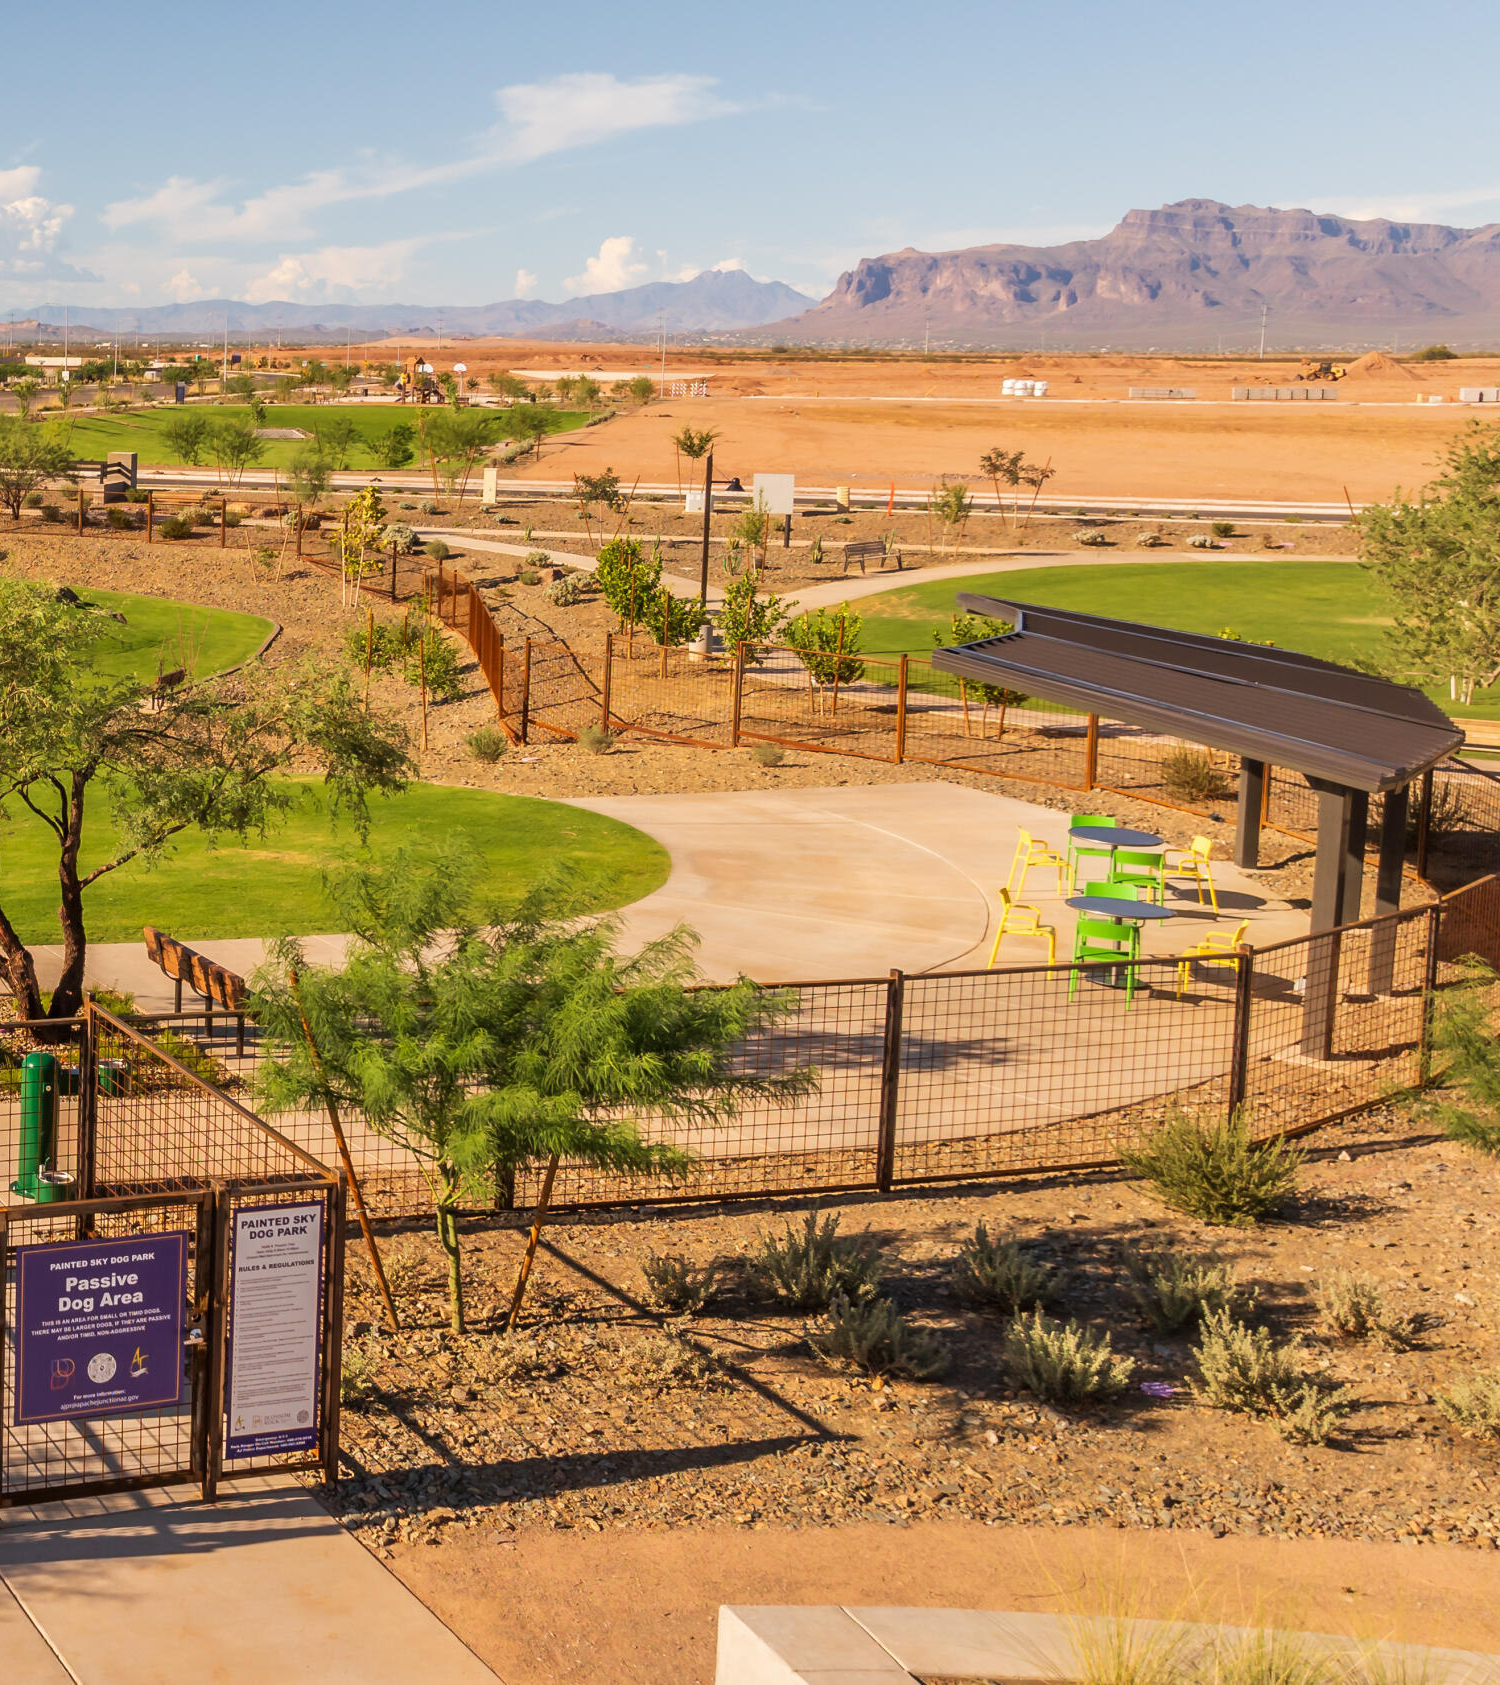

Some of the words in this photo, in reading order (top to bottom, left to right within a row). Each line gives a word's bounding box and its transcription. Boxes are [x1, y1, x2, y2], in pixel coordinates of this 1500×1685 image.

[241, 1216, 290, 1229] PAINTED
[293, 1213, 316, 1224] SKY
[249, 1229, 274, 1240] DOG
[277, 1226, 308, 1237] PARK
[50, 1260, 88, 1271] PAINTED
[90, 1258, 108, 1267] SKY
[111, 1255, 130, 1264] DOG
[132, 1252, 155, 1262] PARK
[268, 1259, 315, 1269] REGULATIONS
[65, 1272, 139, 1292] Passive
[58, 1297, 94, 1312] Dog
[99, 1291, 144, 1307] Area
[72, 1323, 96, 1331] LARGER
[148, 1314, 171, 1322] PASSIVE
[57, 1333, 79, 1341] AND/OR
[97, 1325, 146, 1336] NON-AGGRESSIVE
